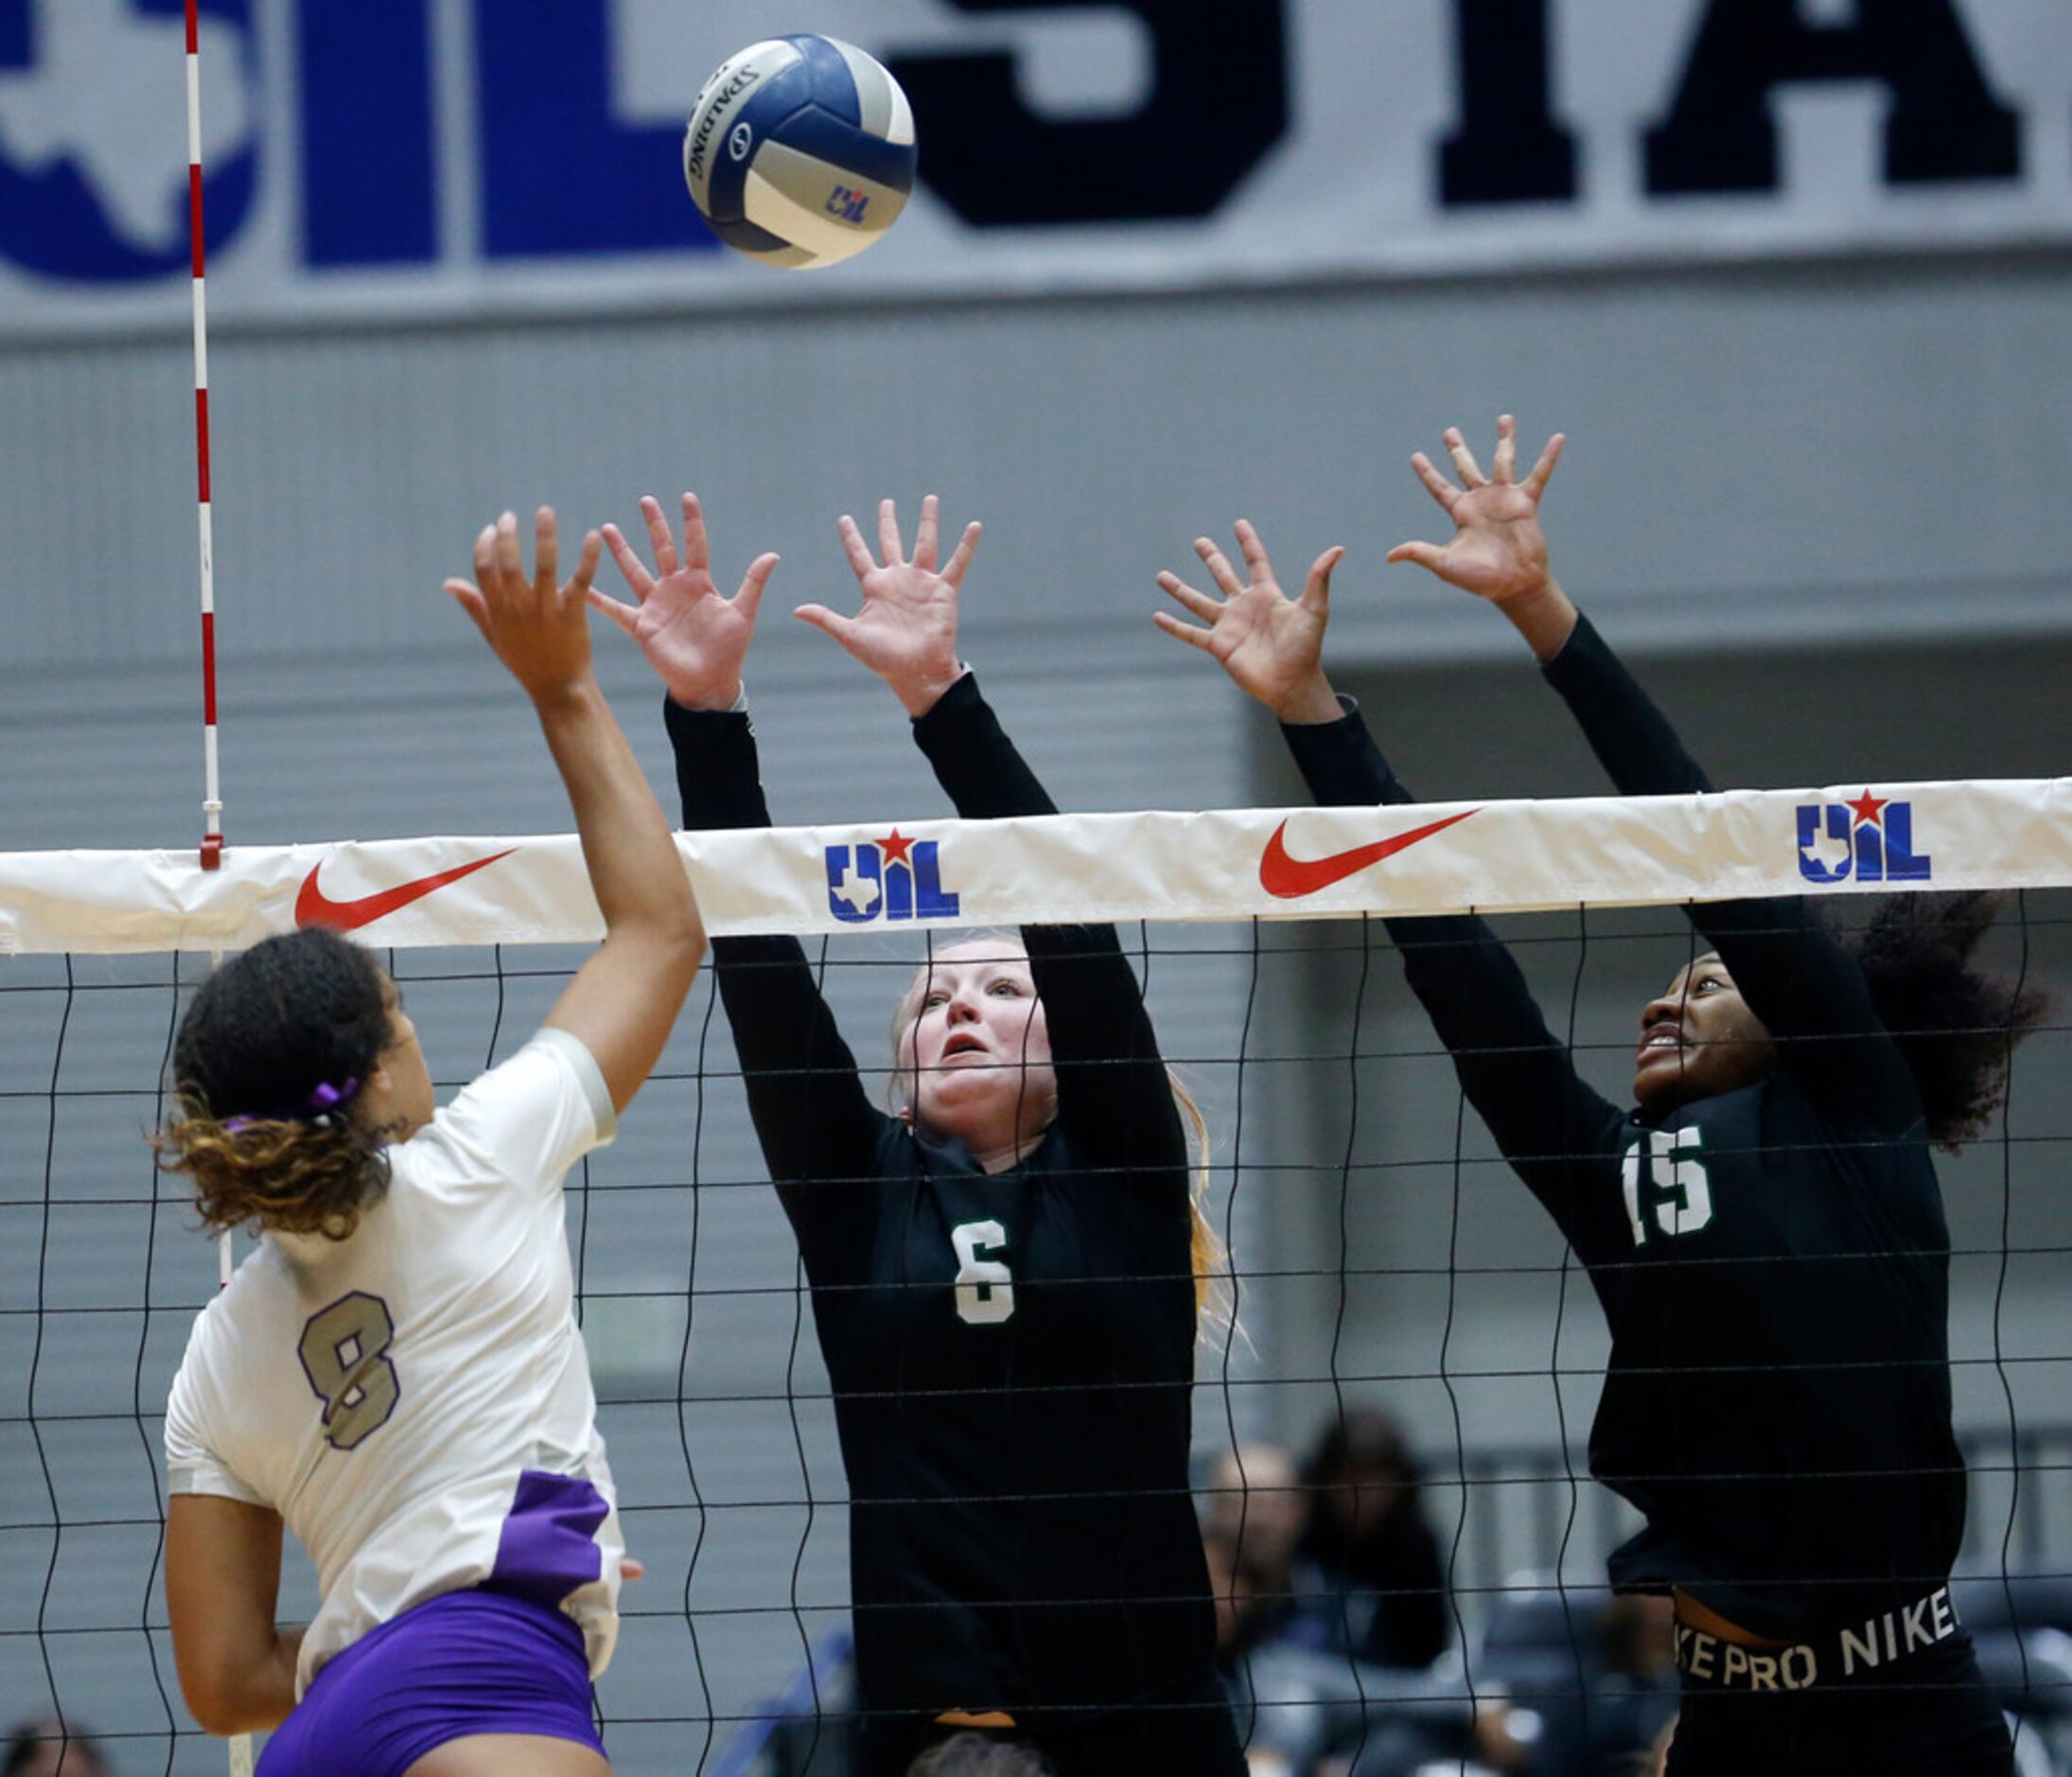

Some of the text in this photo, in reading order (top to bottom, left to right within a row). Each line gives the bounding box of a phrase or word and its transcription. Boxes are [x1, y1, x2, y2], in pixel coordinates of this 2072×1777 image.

[688, 64, 760, 181] SPALDING
[825, 828, 959, 924] UIL
[1796, 788, 1931, 884] UIL
[1622, 1126, 1712, 1246] 15
[951, 1220, 1015, 1324] 6
[297, 1290, 401, 1452] 8
[1723, 1643, 1817, 1691] PRO
[1840, 1586, 1956, 1676] NIKE
